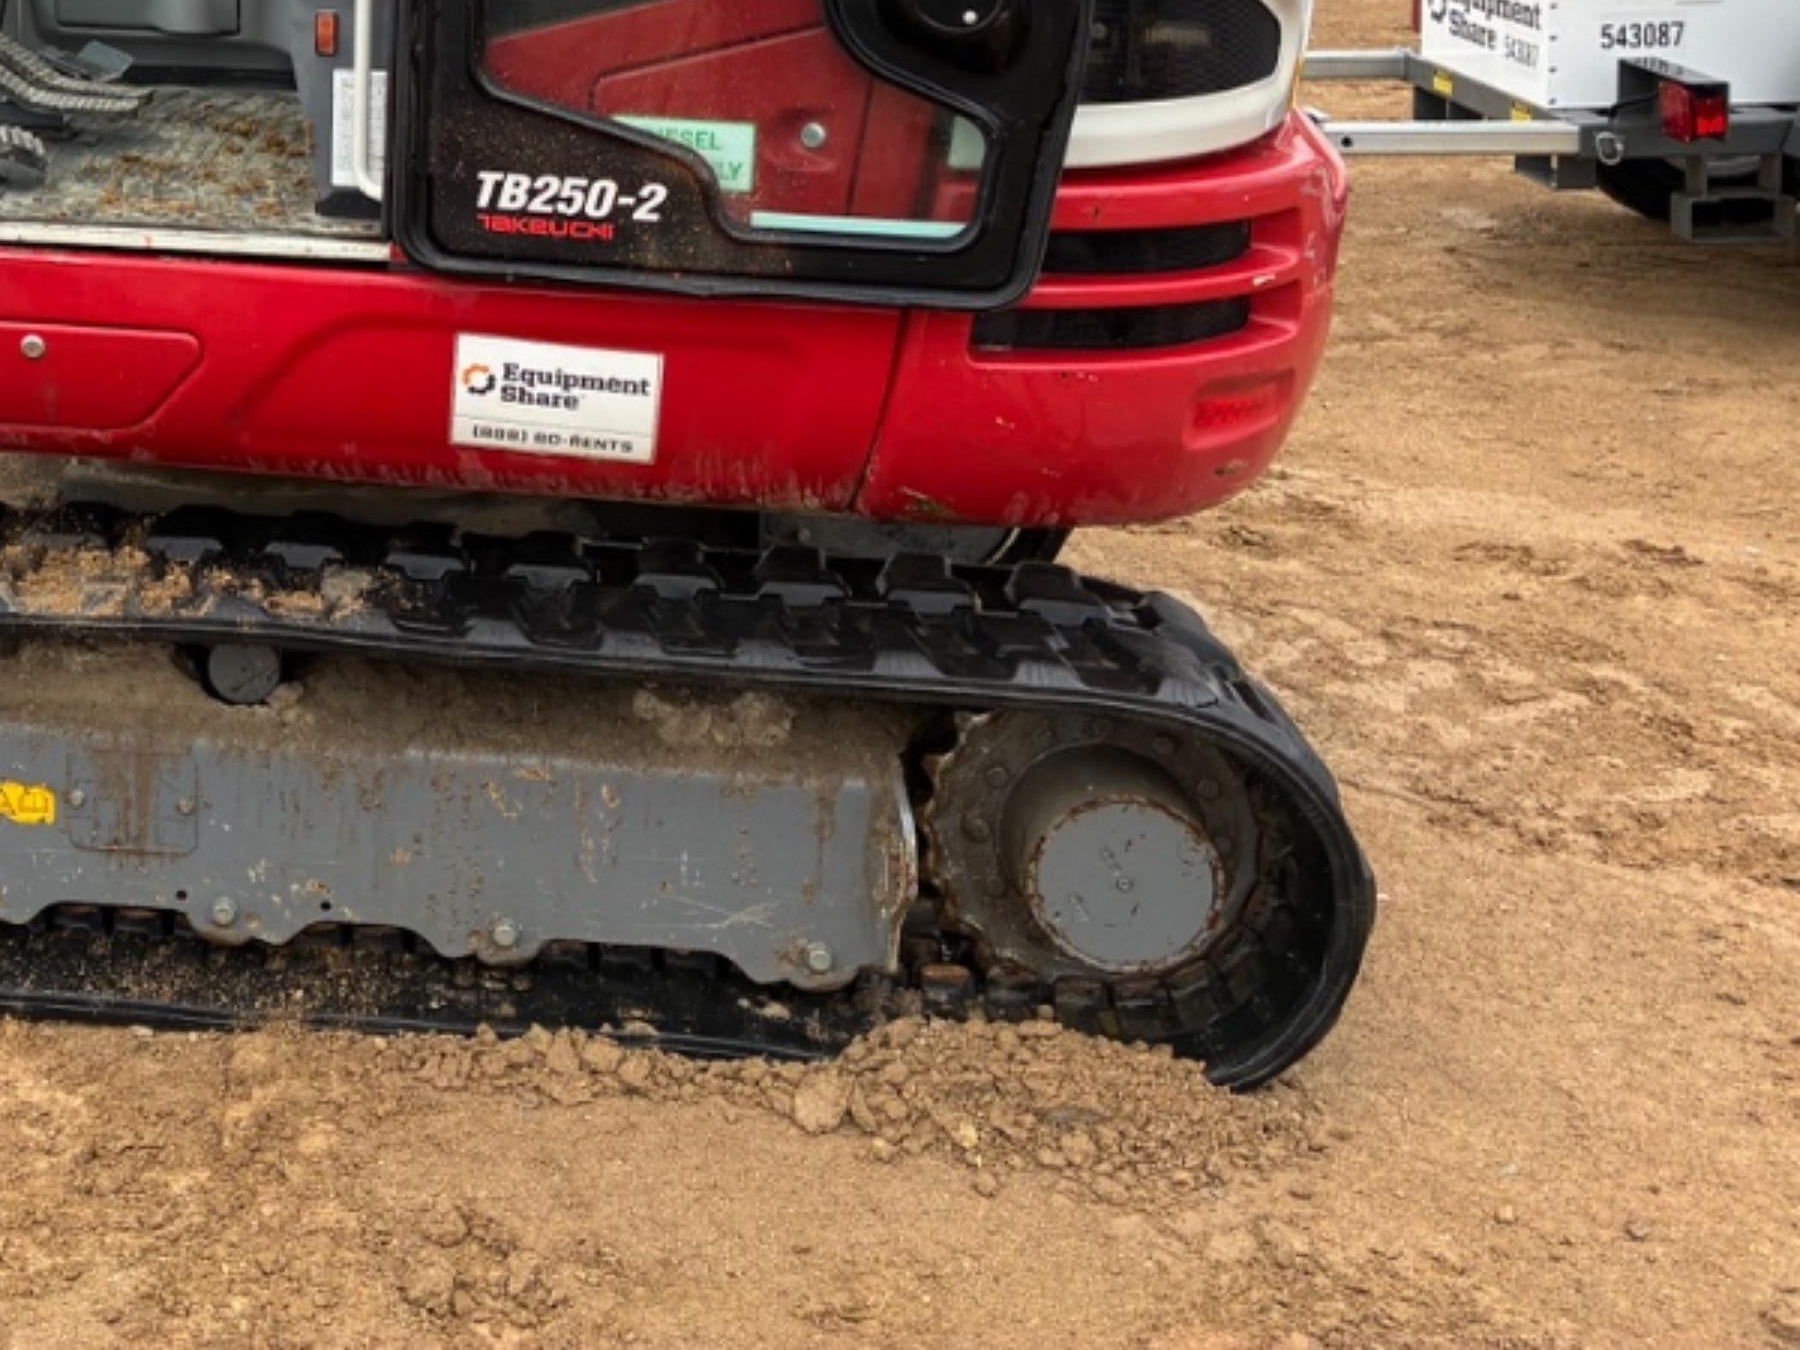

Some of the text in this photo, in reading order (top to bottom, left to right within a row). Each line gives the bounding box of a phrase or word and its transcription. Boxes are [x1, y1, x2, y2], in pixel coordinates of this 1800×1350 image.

[1449, 9, 1497, 50] Share
[1601, 20, 1684, 50] 543087
[476, 170, 668, 223] TB250-2
[477, 213, 614, 241] TAKEUCHI
[502, 362, 651, 397] Equipment
[500, 385, 580, 411] Share
